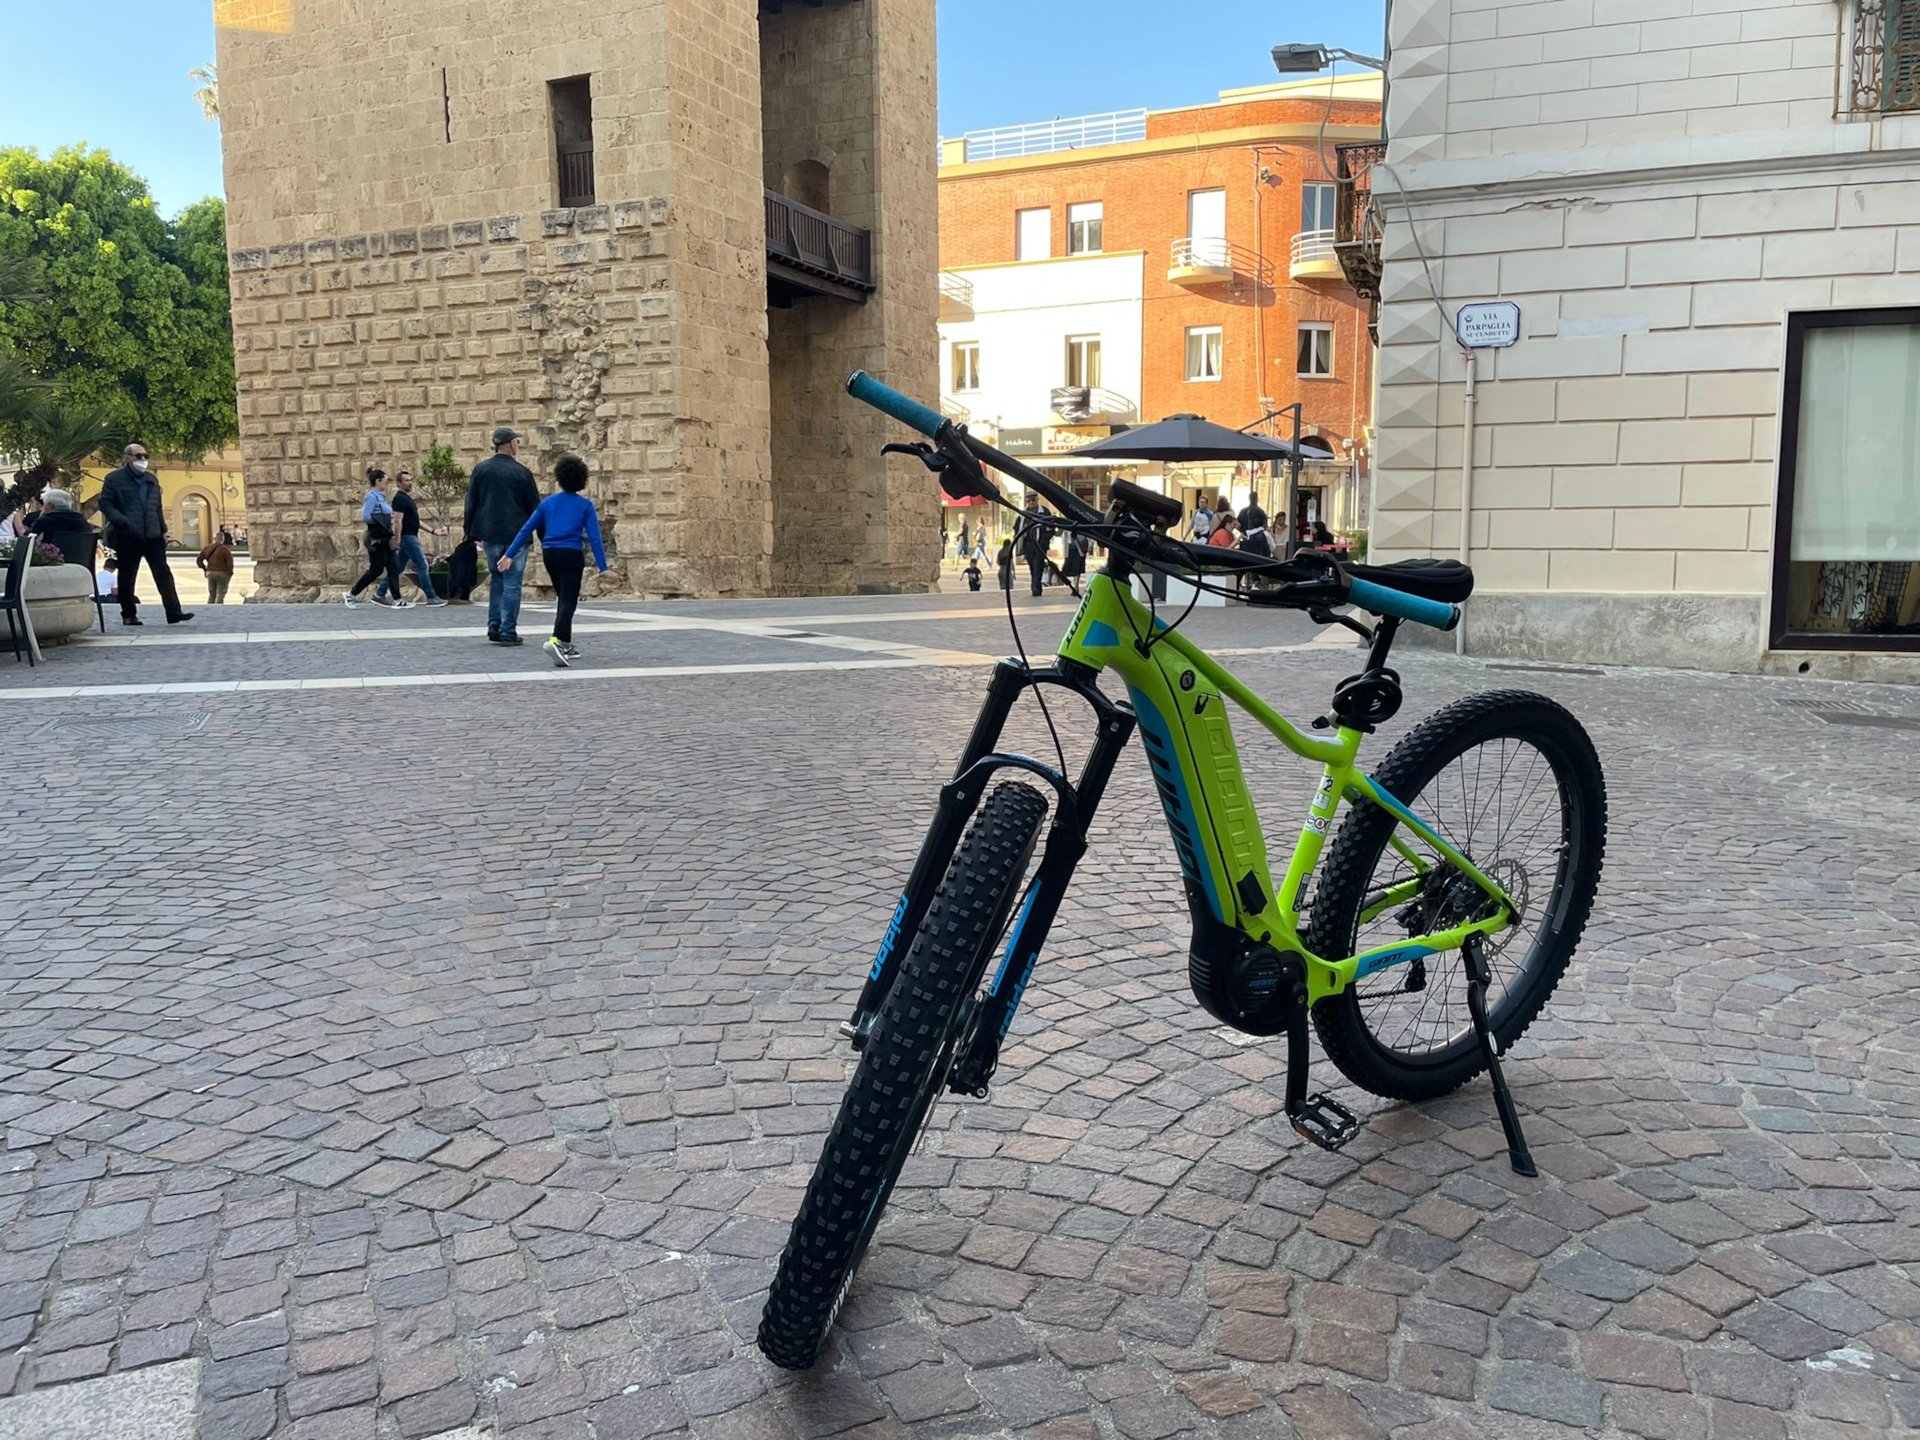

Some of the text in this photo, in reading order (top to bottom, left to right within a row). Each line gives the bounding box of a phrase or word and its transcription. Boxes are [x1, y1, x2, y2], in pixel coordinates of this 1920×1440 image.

[1465, 322, 1511, 331] PARPAGLIA
[1483, 313, 1498, 321] VIA
[869, 894, 909, 981] raidon
[1000, 952, 1039, 1037] raidon
